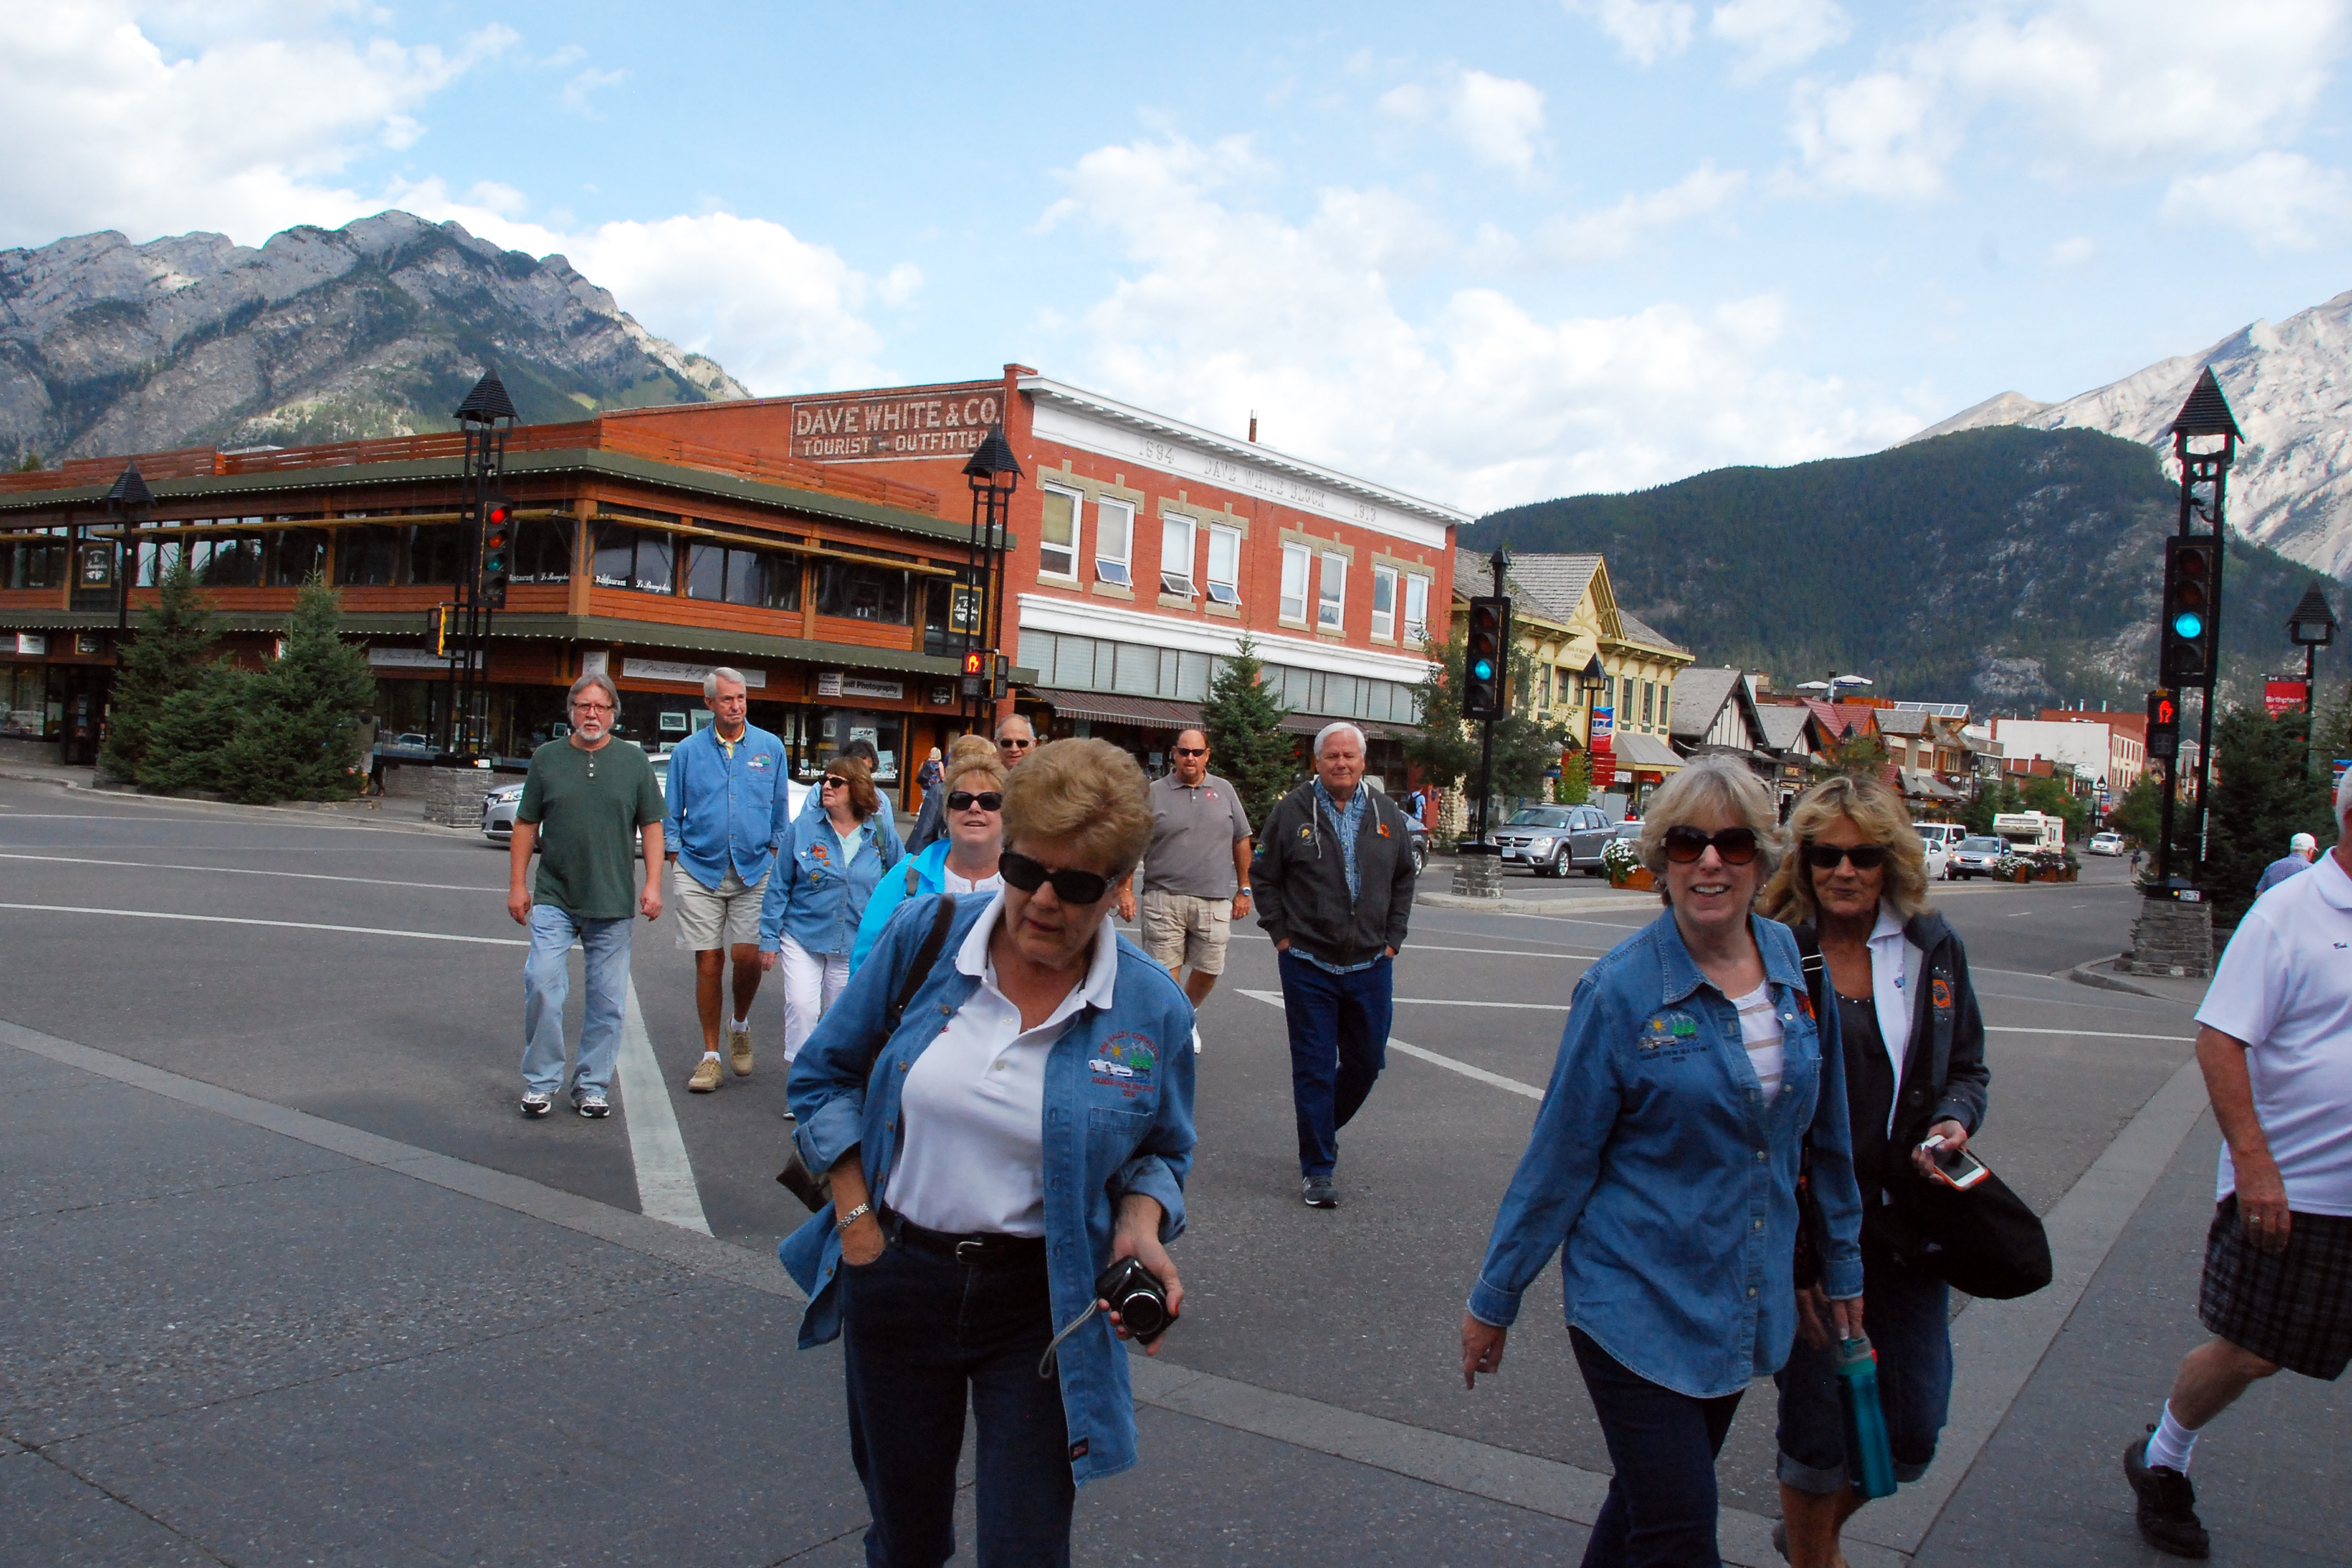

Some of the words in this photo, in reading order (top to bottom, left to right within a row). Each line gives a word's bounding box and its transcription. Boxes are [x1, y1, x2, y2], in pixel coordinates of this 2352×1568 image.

[796, 407, 859, 436] DAVE
[864, 400, 941, 432] WHITE
[945, 403, 959, 426] &
[964, 397, 1000, 425] CO.
[803, 437, 872, 456] TOURIST
[1139, 438, 1174, 464] 1894
[1203, 458, 1237, 482] DAVE
[1245, 469, 1284, 496] WHITE
[1290, 482, 1325, 508] BLOCK
[595, 575, 627, 587] Restaurant
[857, 681, 898, 693] Photography
